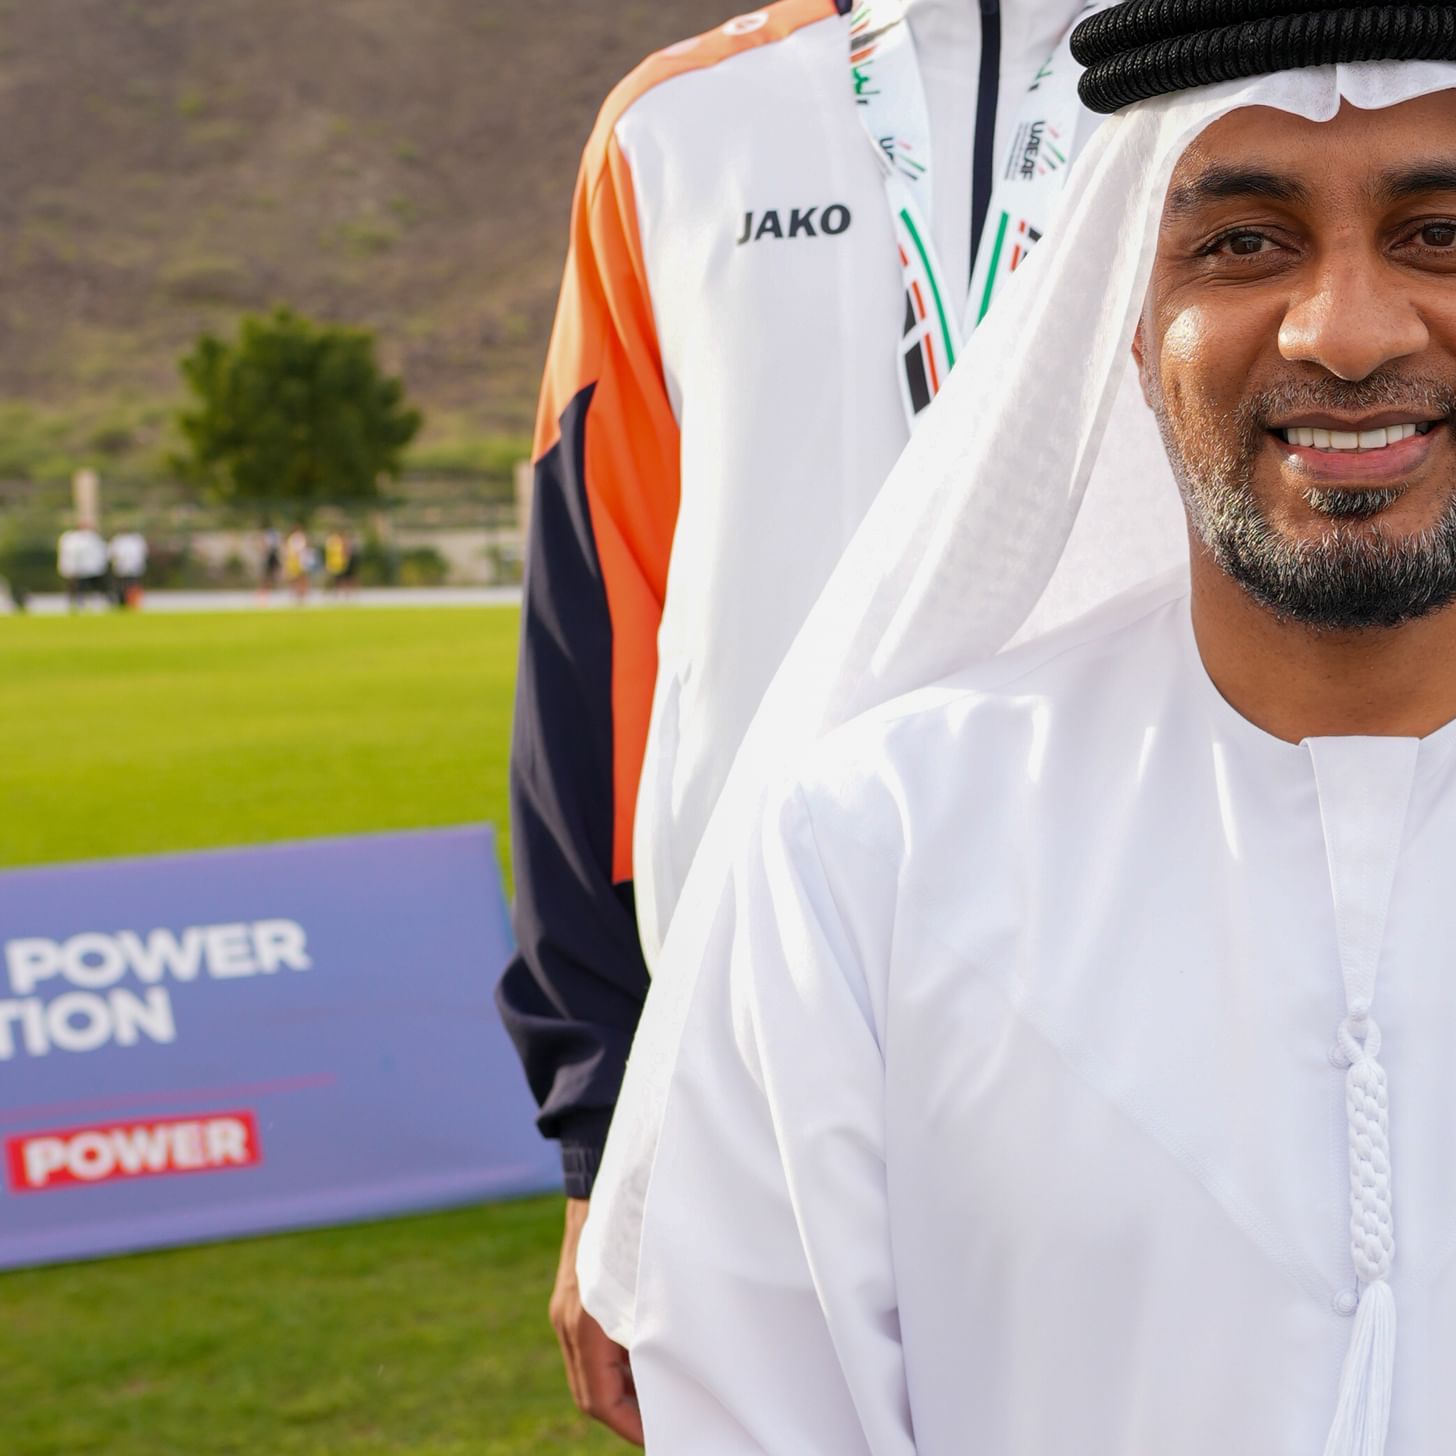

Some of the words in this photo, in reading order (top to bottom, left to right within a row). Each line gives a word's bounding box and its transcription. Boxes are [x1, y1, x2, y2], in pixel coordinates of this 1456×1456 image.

[737, 204, 851, 246] JAKO
[6, 918, 312, 994] POWER
[23, 1117, 248, 1187] POWER
